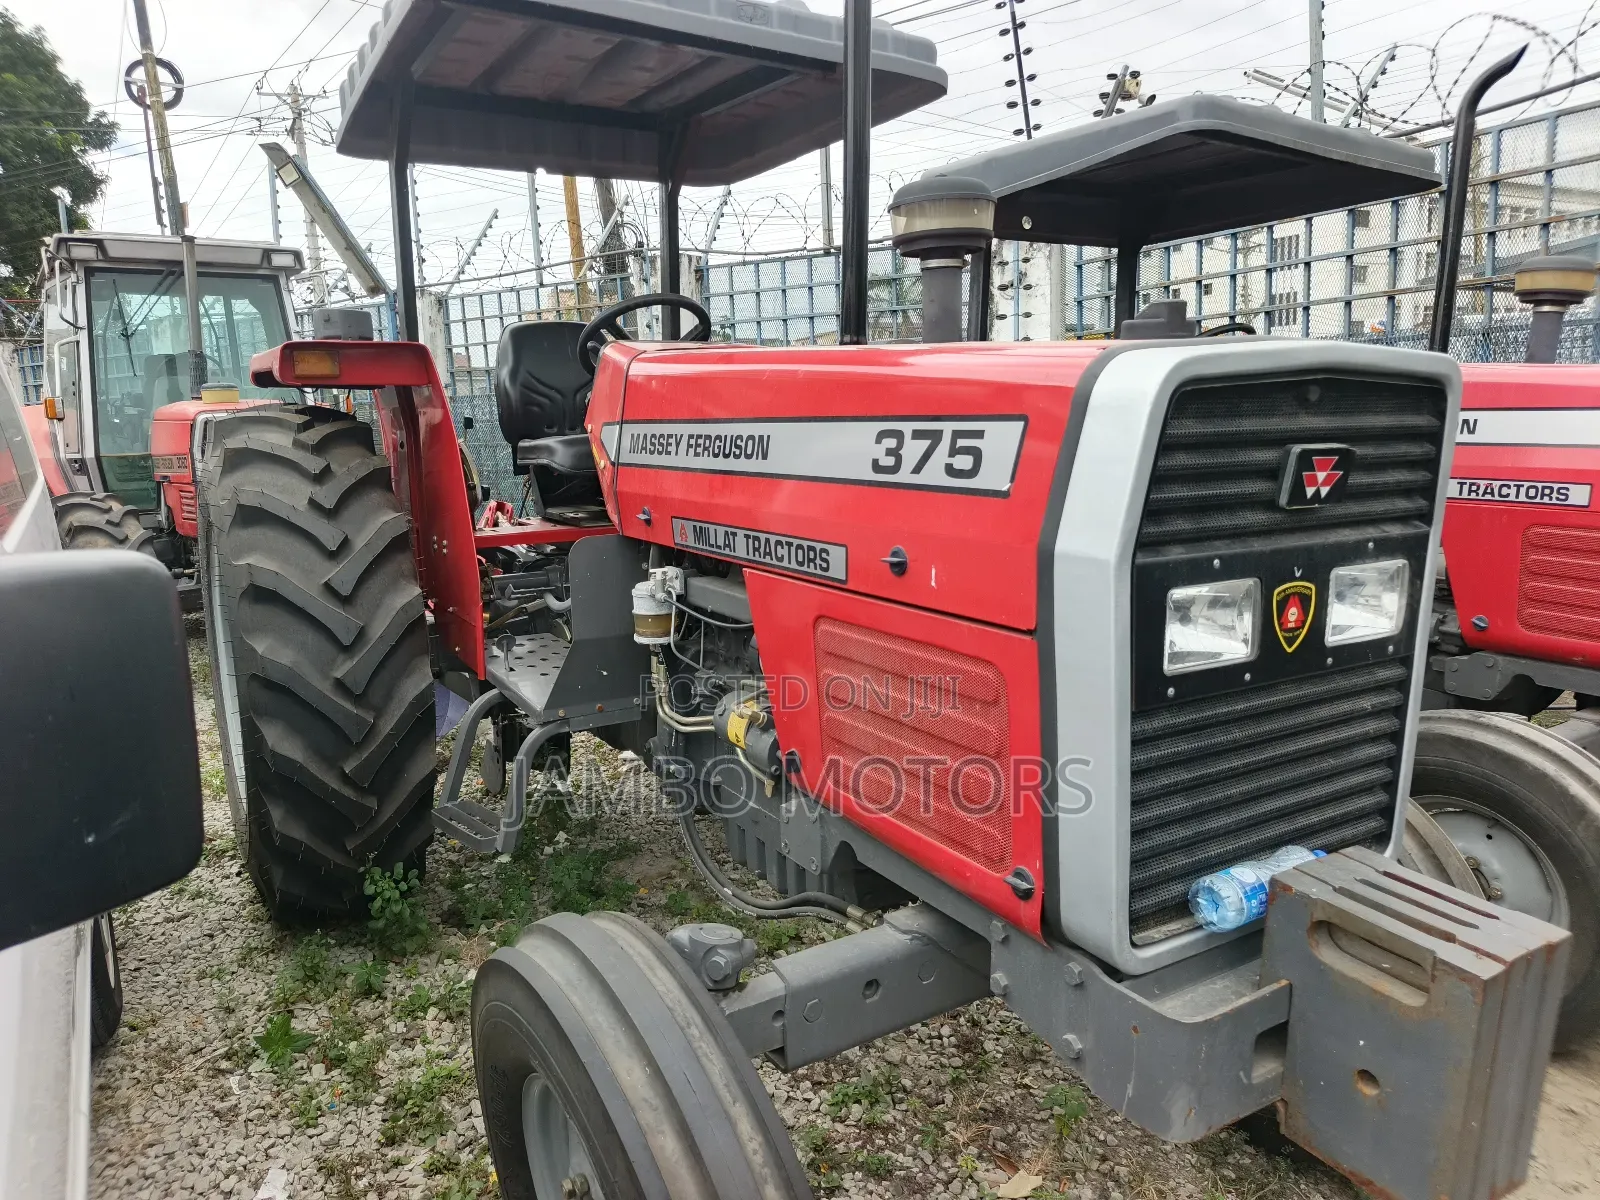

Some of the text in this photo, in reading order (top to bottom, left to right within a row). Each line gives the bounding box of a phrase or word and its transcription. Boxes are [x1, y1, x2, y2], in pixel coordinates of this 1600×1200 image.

[1458, 418, 1478, 434] N
[629, 429, 986, 480] MASSEY FERGUSON 375
[1457, 481, 1570, 502] TRACTORS
[692, 524, 831, 572] MILLAT TRACTORS
